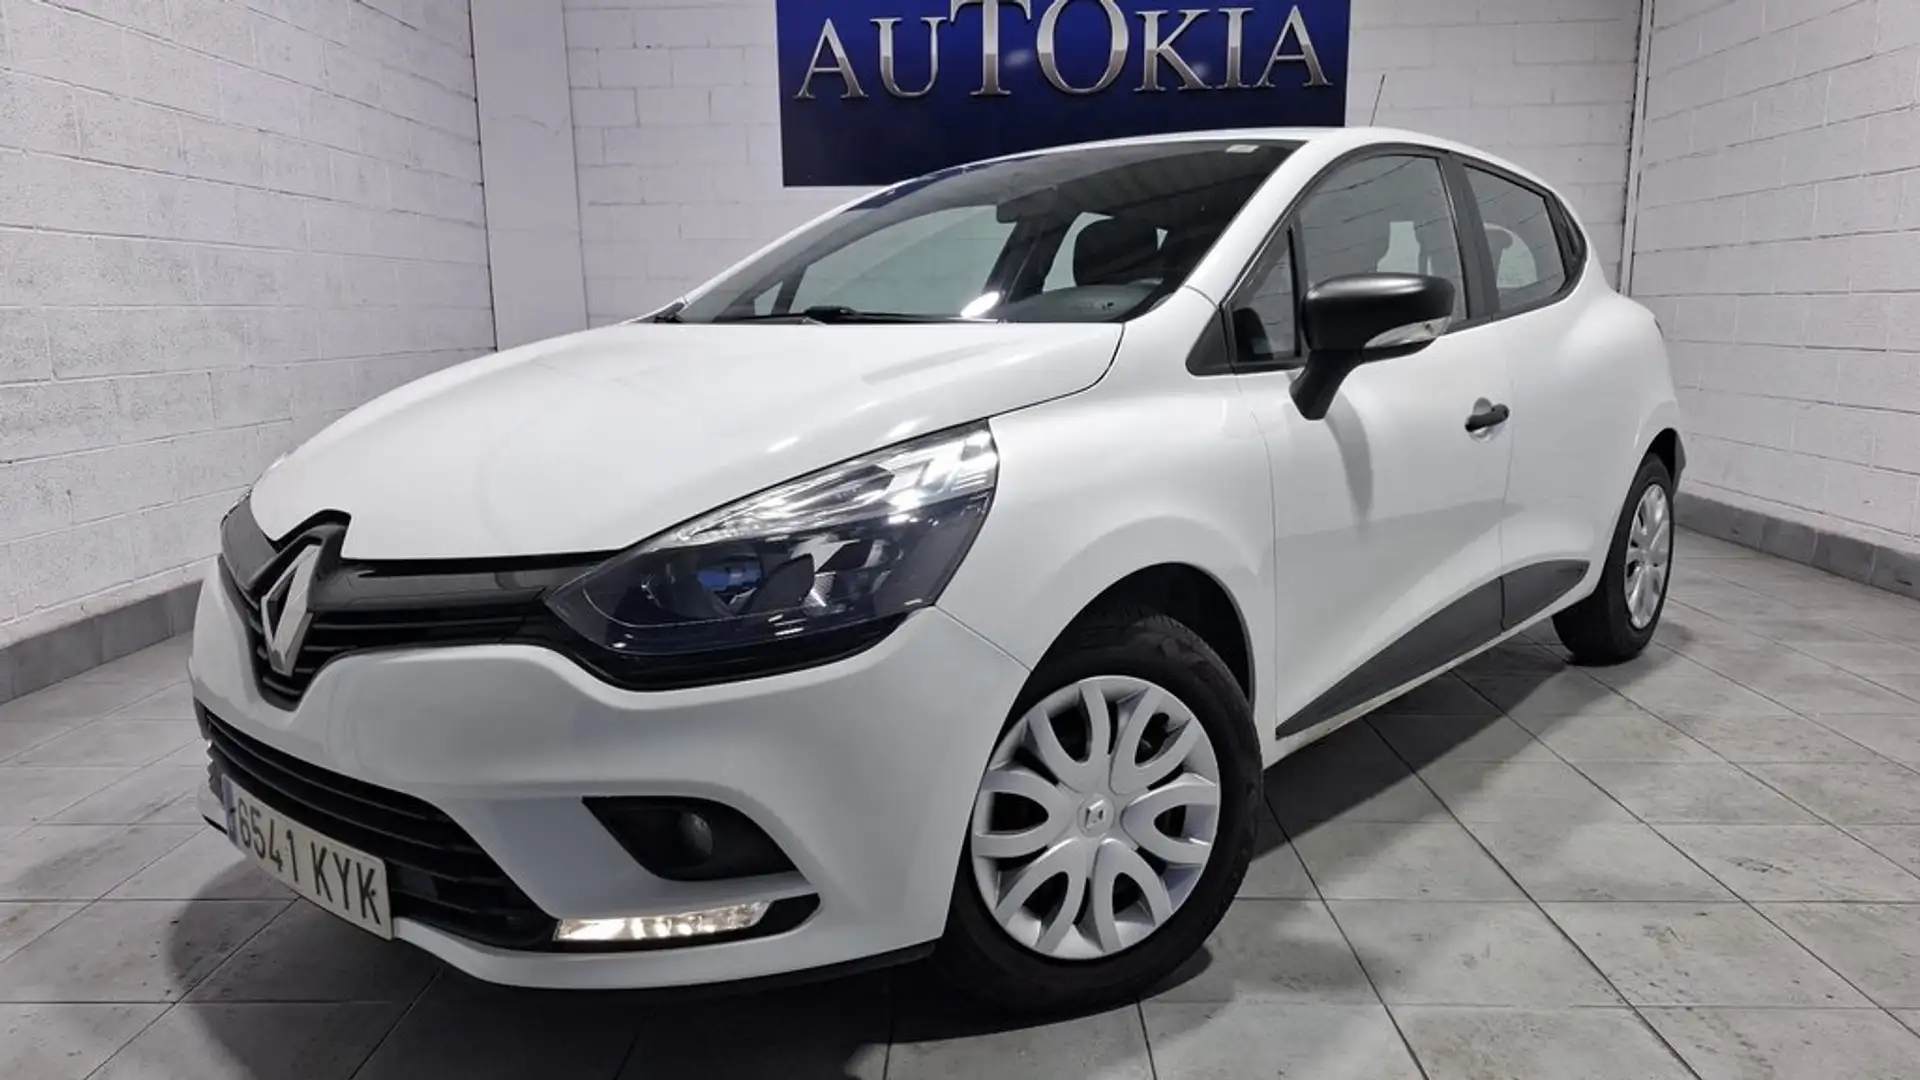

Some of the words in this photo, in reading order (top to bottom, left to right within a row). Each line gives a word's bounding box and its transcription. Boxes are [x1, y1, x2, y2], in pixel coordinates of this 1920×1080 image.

[794, 0, 1333, 99] AUTOKIA
[237, 797, 299, 883] 6541
[310, 841, 381, 925] KYK
